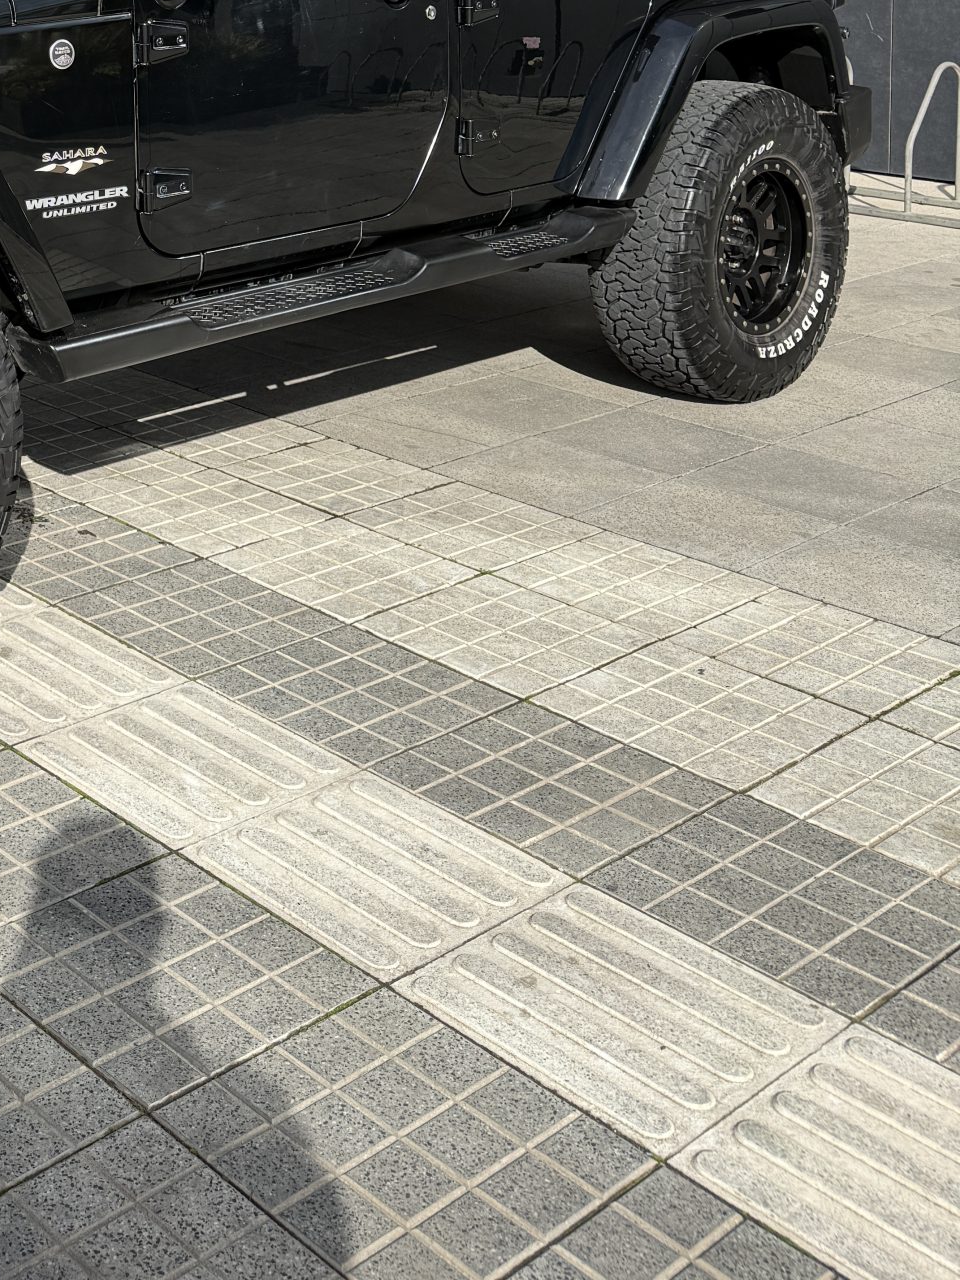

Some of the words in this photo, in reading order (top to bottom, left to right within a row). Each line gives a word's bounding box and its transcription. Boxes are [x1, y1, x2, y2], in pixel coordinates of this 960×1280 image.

[42, 146, 107, 162] SAHARA
[26, 186, 129, 210] WRANGLER
[42, 201, 117, 219] UNLIMITED
[758, 271, 829, 360] ROADCRUZA
